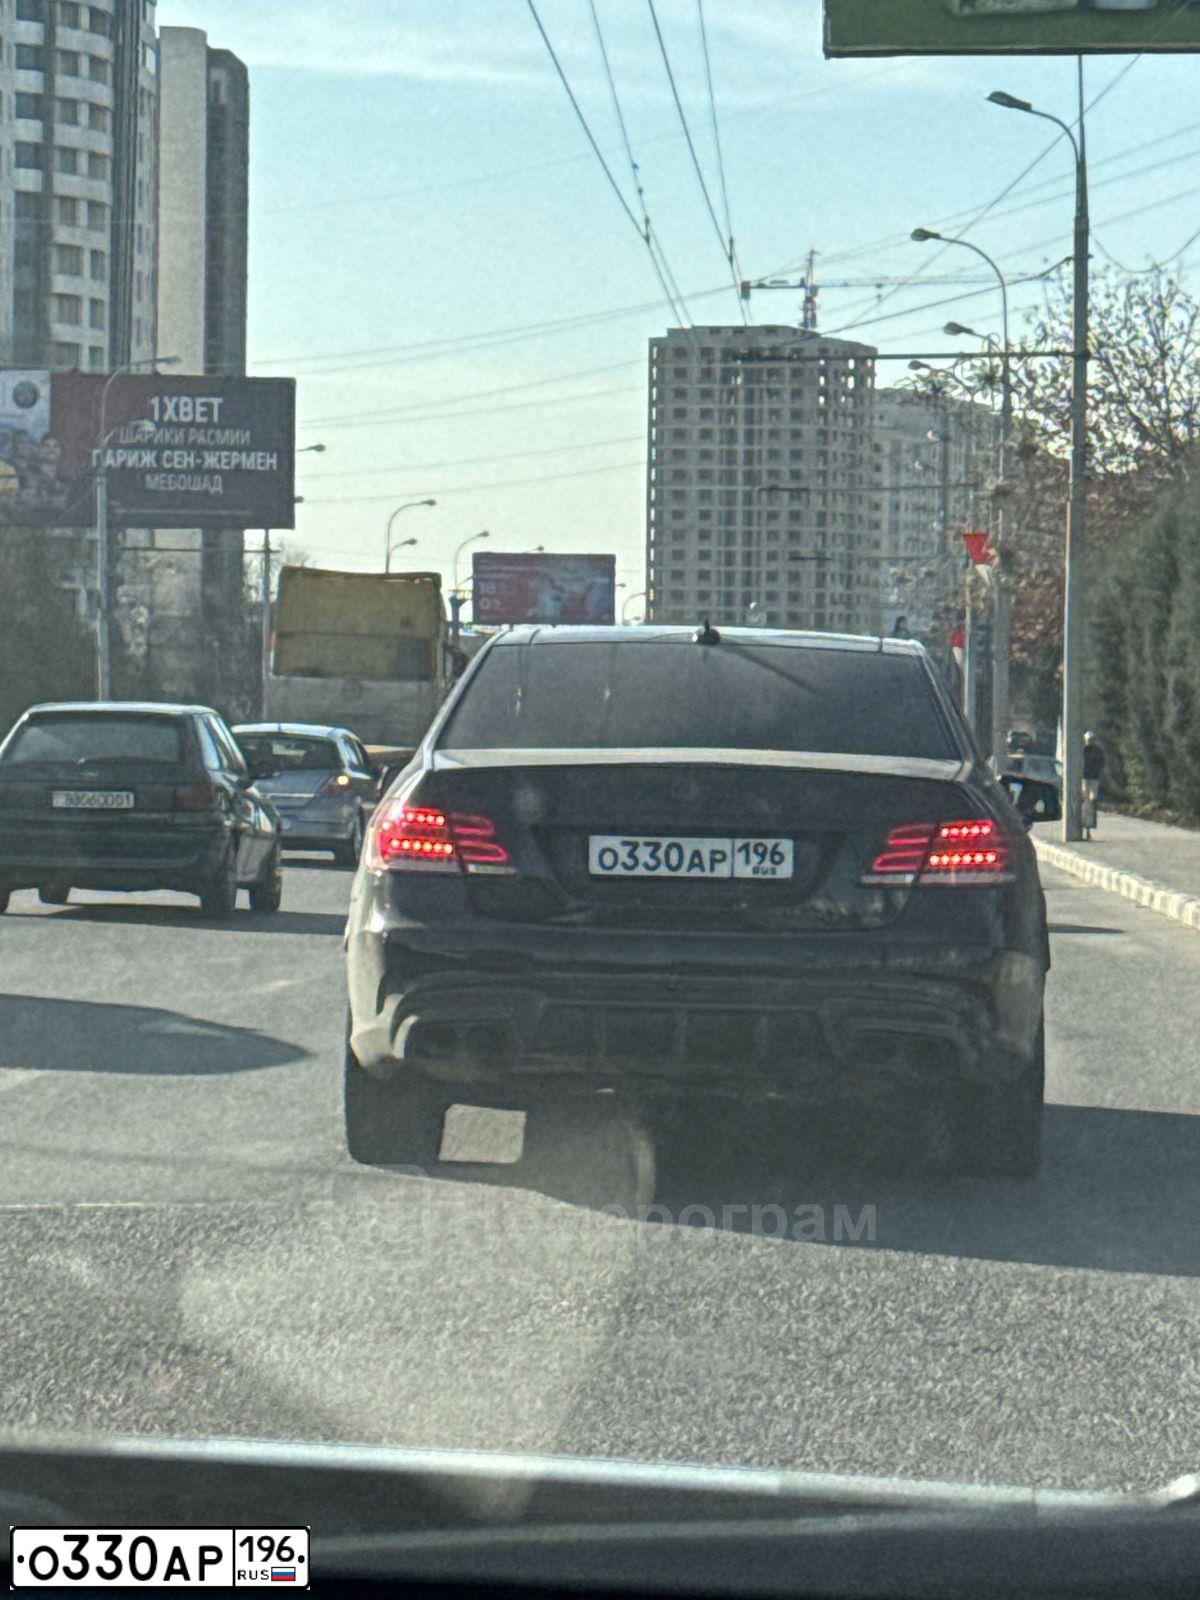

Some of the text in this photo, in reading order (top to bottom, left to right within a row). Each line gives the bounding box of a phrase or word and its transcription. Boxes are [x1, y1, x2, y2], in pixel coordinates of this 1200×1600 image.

[161, 451, 278, 471] СЕН-ЖЕРМЕН
[598, 840, 785, 873] О330АР 196
